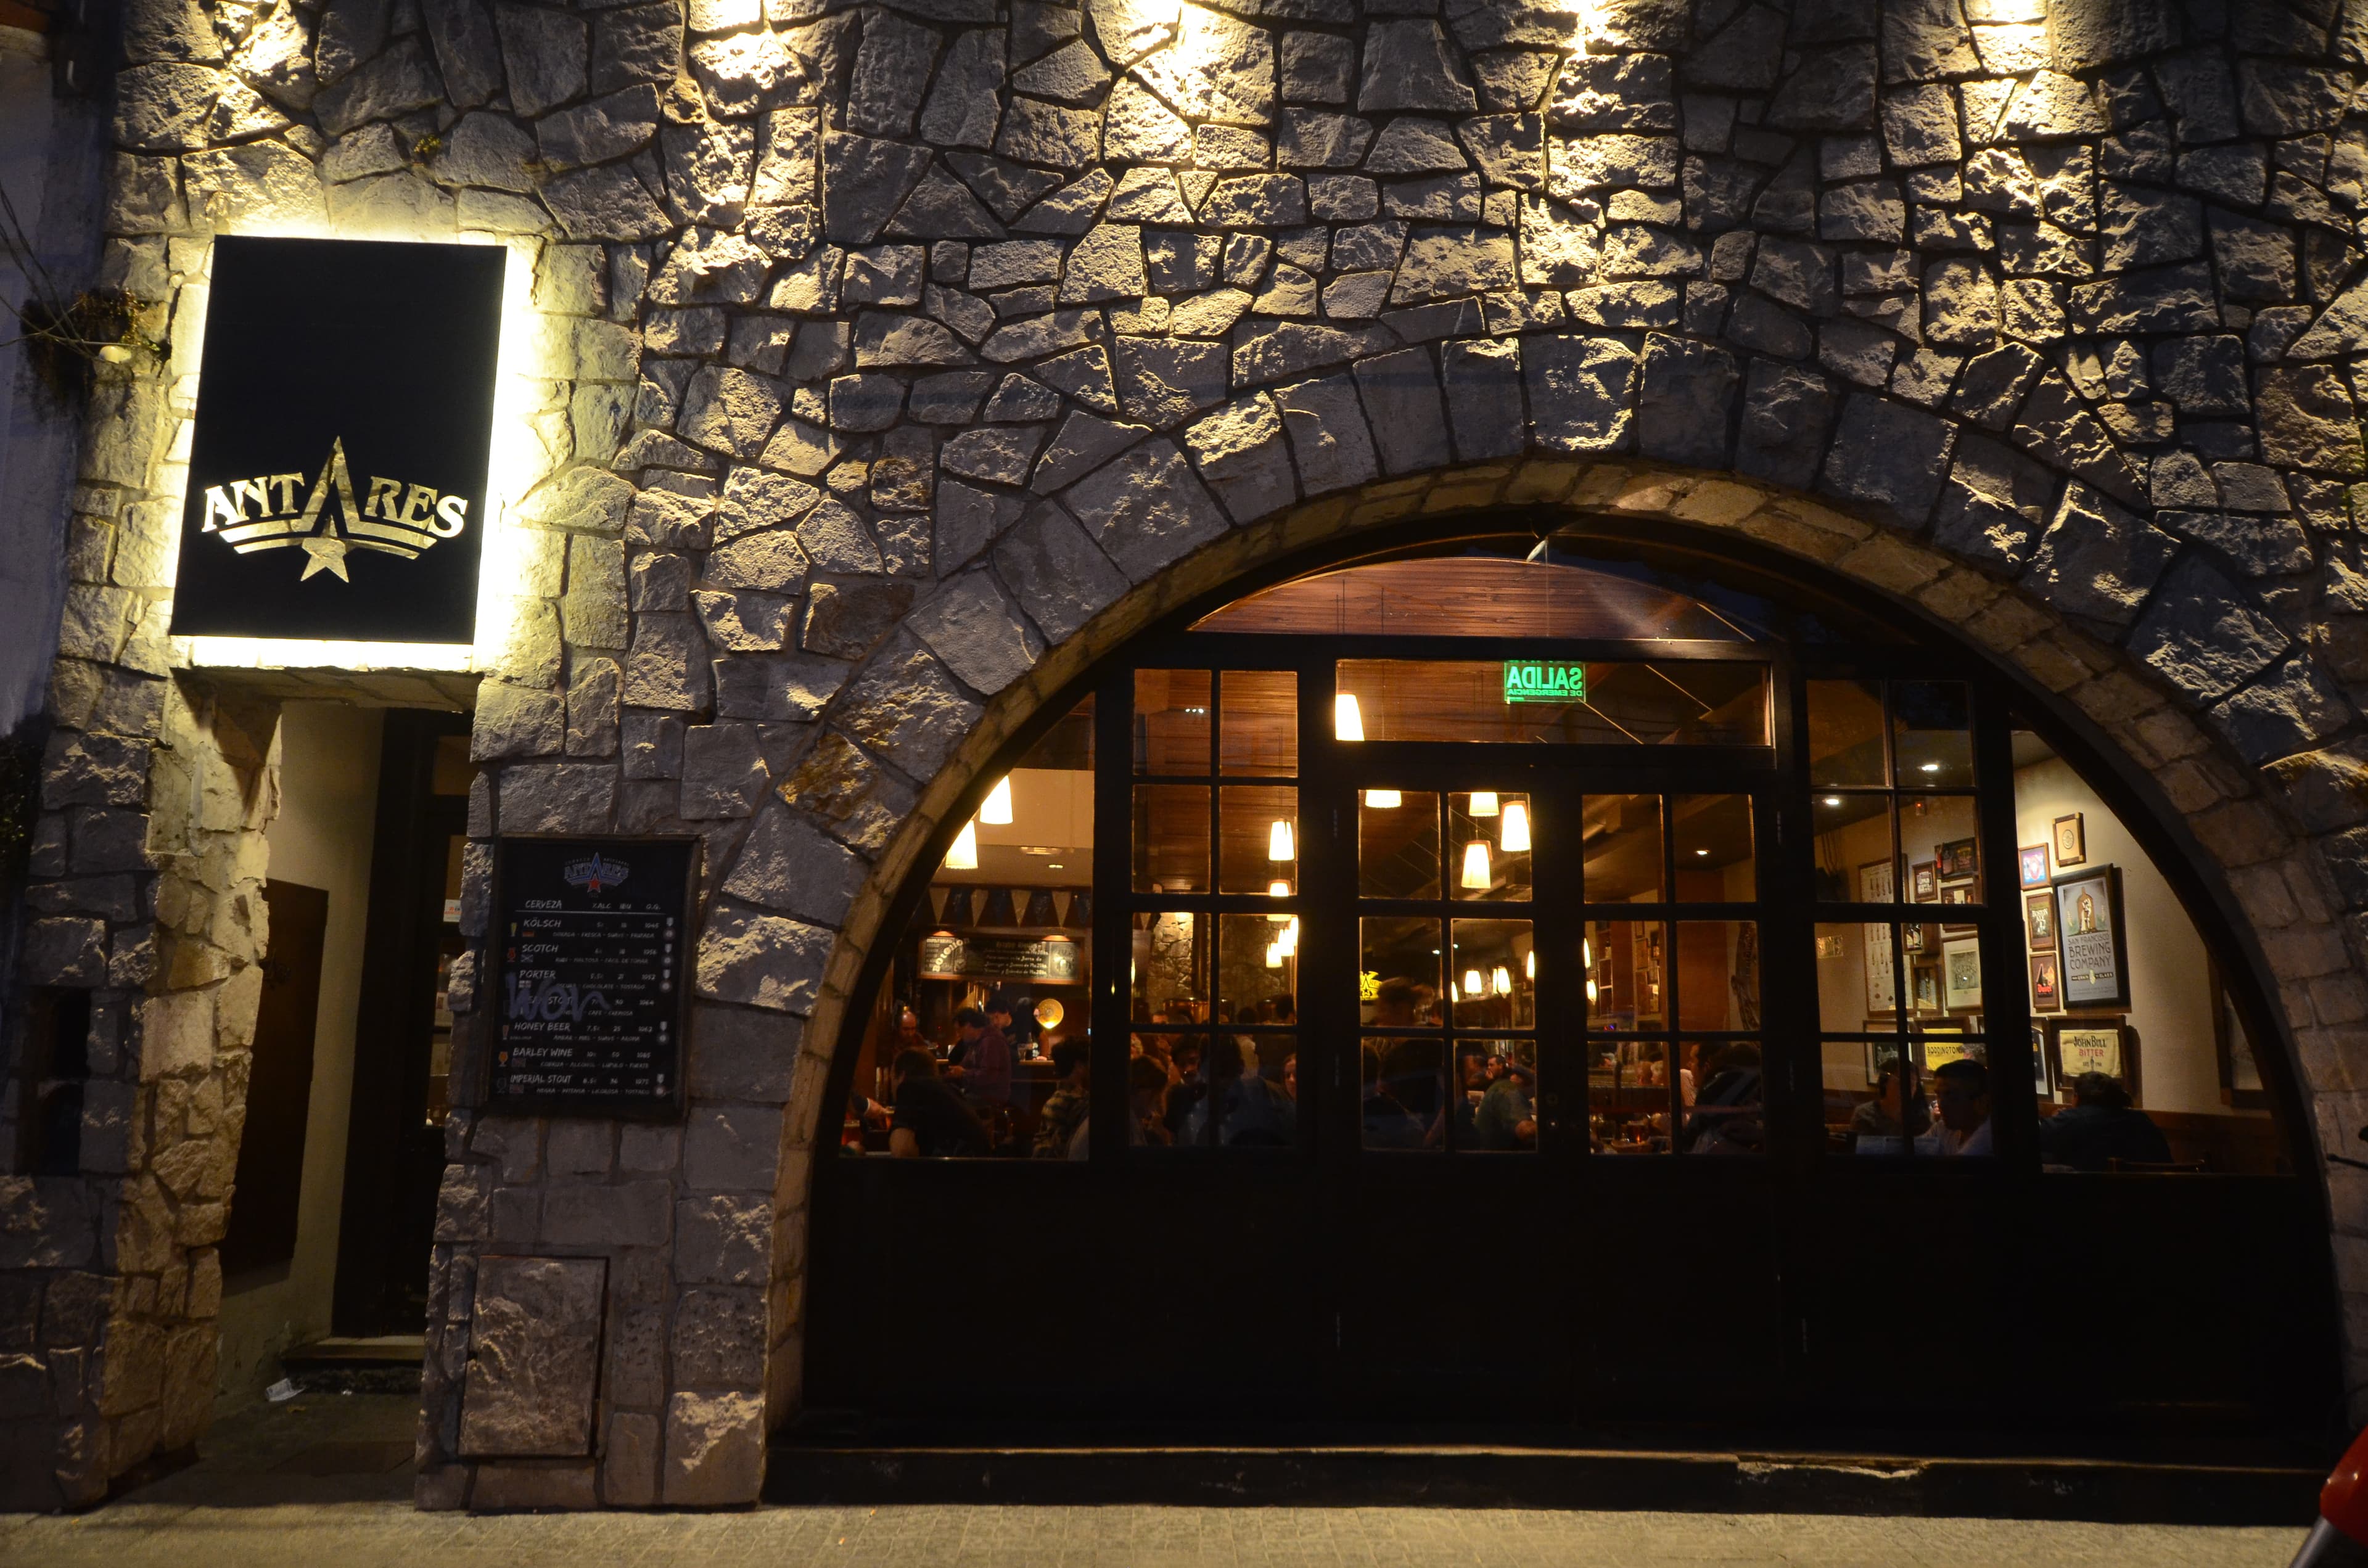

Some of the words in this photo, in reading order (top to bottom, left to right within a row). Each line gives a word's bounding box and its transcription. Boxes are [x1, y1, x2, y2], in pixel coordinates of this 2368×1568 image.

[202, 435, 468, 538] ANTARES
[564, 852, 629, 880] ANTARES
[525, 899, 562, 909] CERVEZA
[523, 917, 562, 928] KÖLSCH
[2067, 938, 2079, 946] SAN
[2081, 934, 2110, 943] FRANCISCO
[522, 943, 559, 953] SCOTCH
[2069, 942, 2111, 958] BREWING
[2070, 955, 2111, 971] COMPANY
[519, 969, 557, 980] PORTER
[514, 1022, 545, 1032] HONEY
[547, 1022, 571, 1033] BEER
[512, 1047, 548, 1057] BARLEY
[550, 1048, 573, 1057] WINE
[2079, 1048, 2104, 1057] BITTER
[510, 1074, 545, 1084] IMPERIAL
[547, 1074, 573, 1084] STOUT
